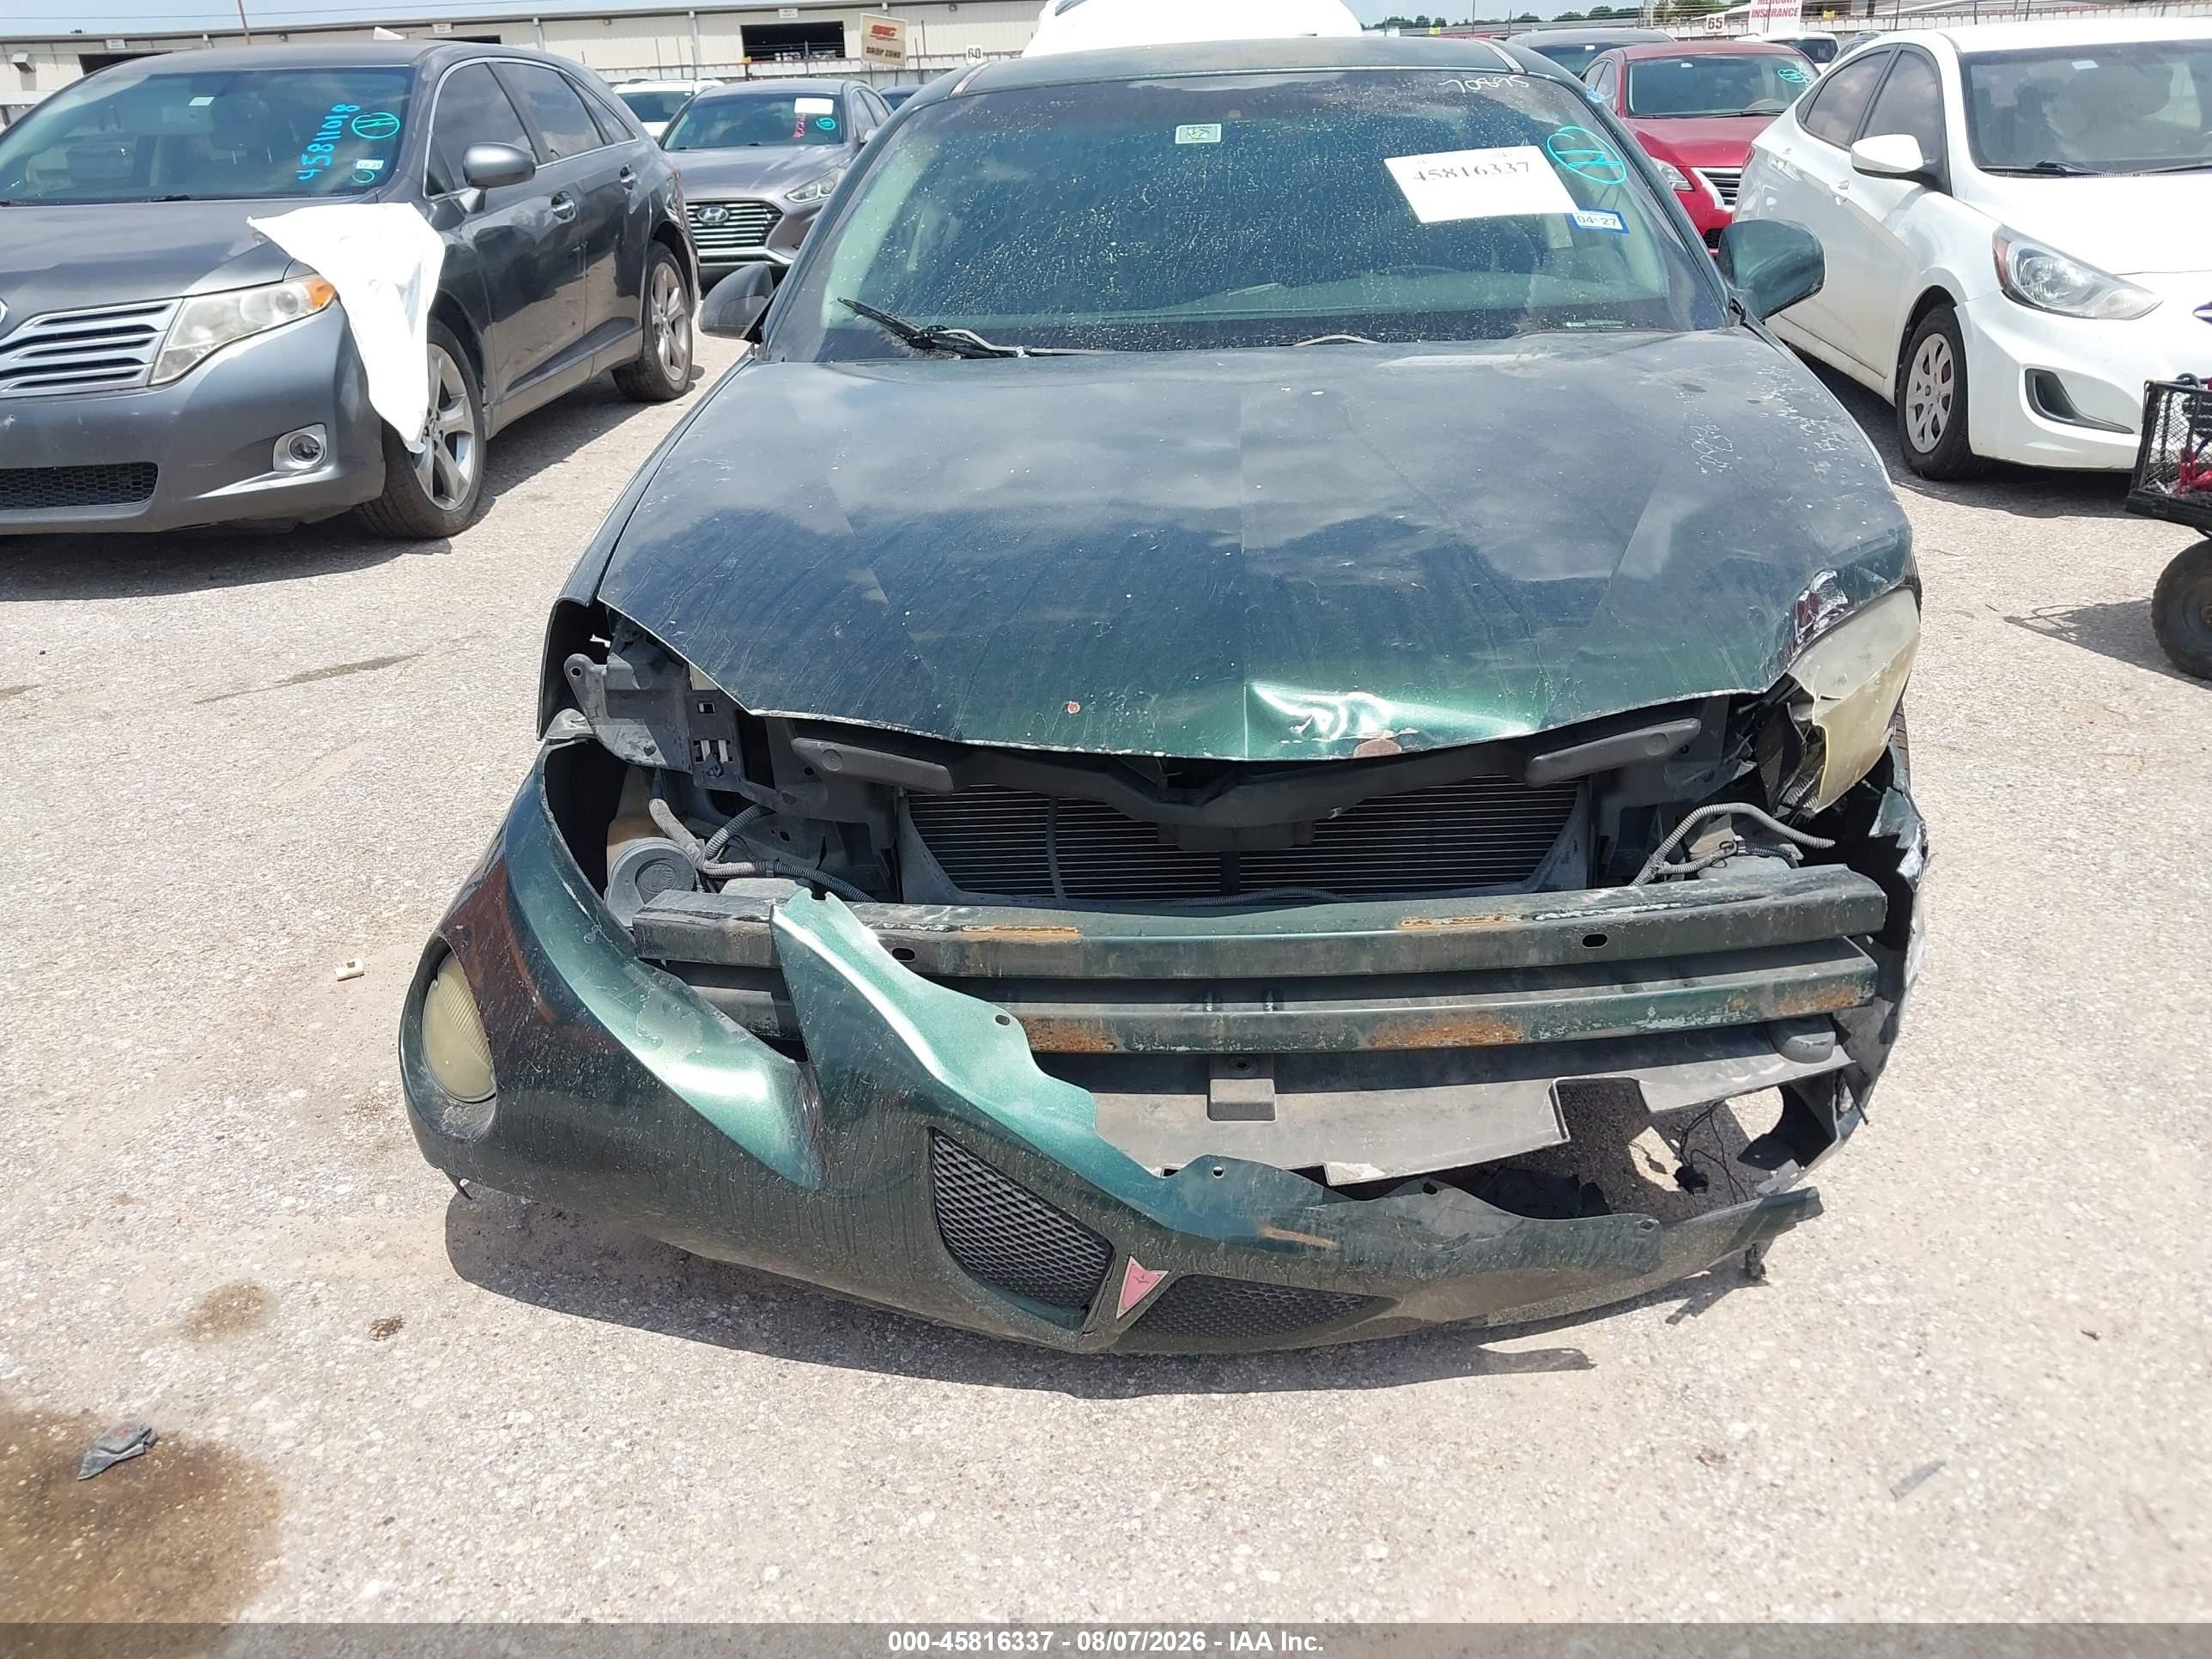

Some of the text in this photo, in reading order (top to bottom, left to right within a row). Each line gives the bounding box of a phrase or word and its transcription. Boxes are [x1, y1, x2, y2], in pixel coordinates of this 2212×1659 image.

[1751, 7, 1800, 18] INSURANCE
[1707, 16, 1723, 30] 65
[968, 47, 981, 59] 60
[1413, 161, 1530, 182] 45816337
